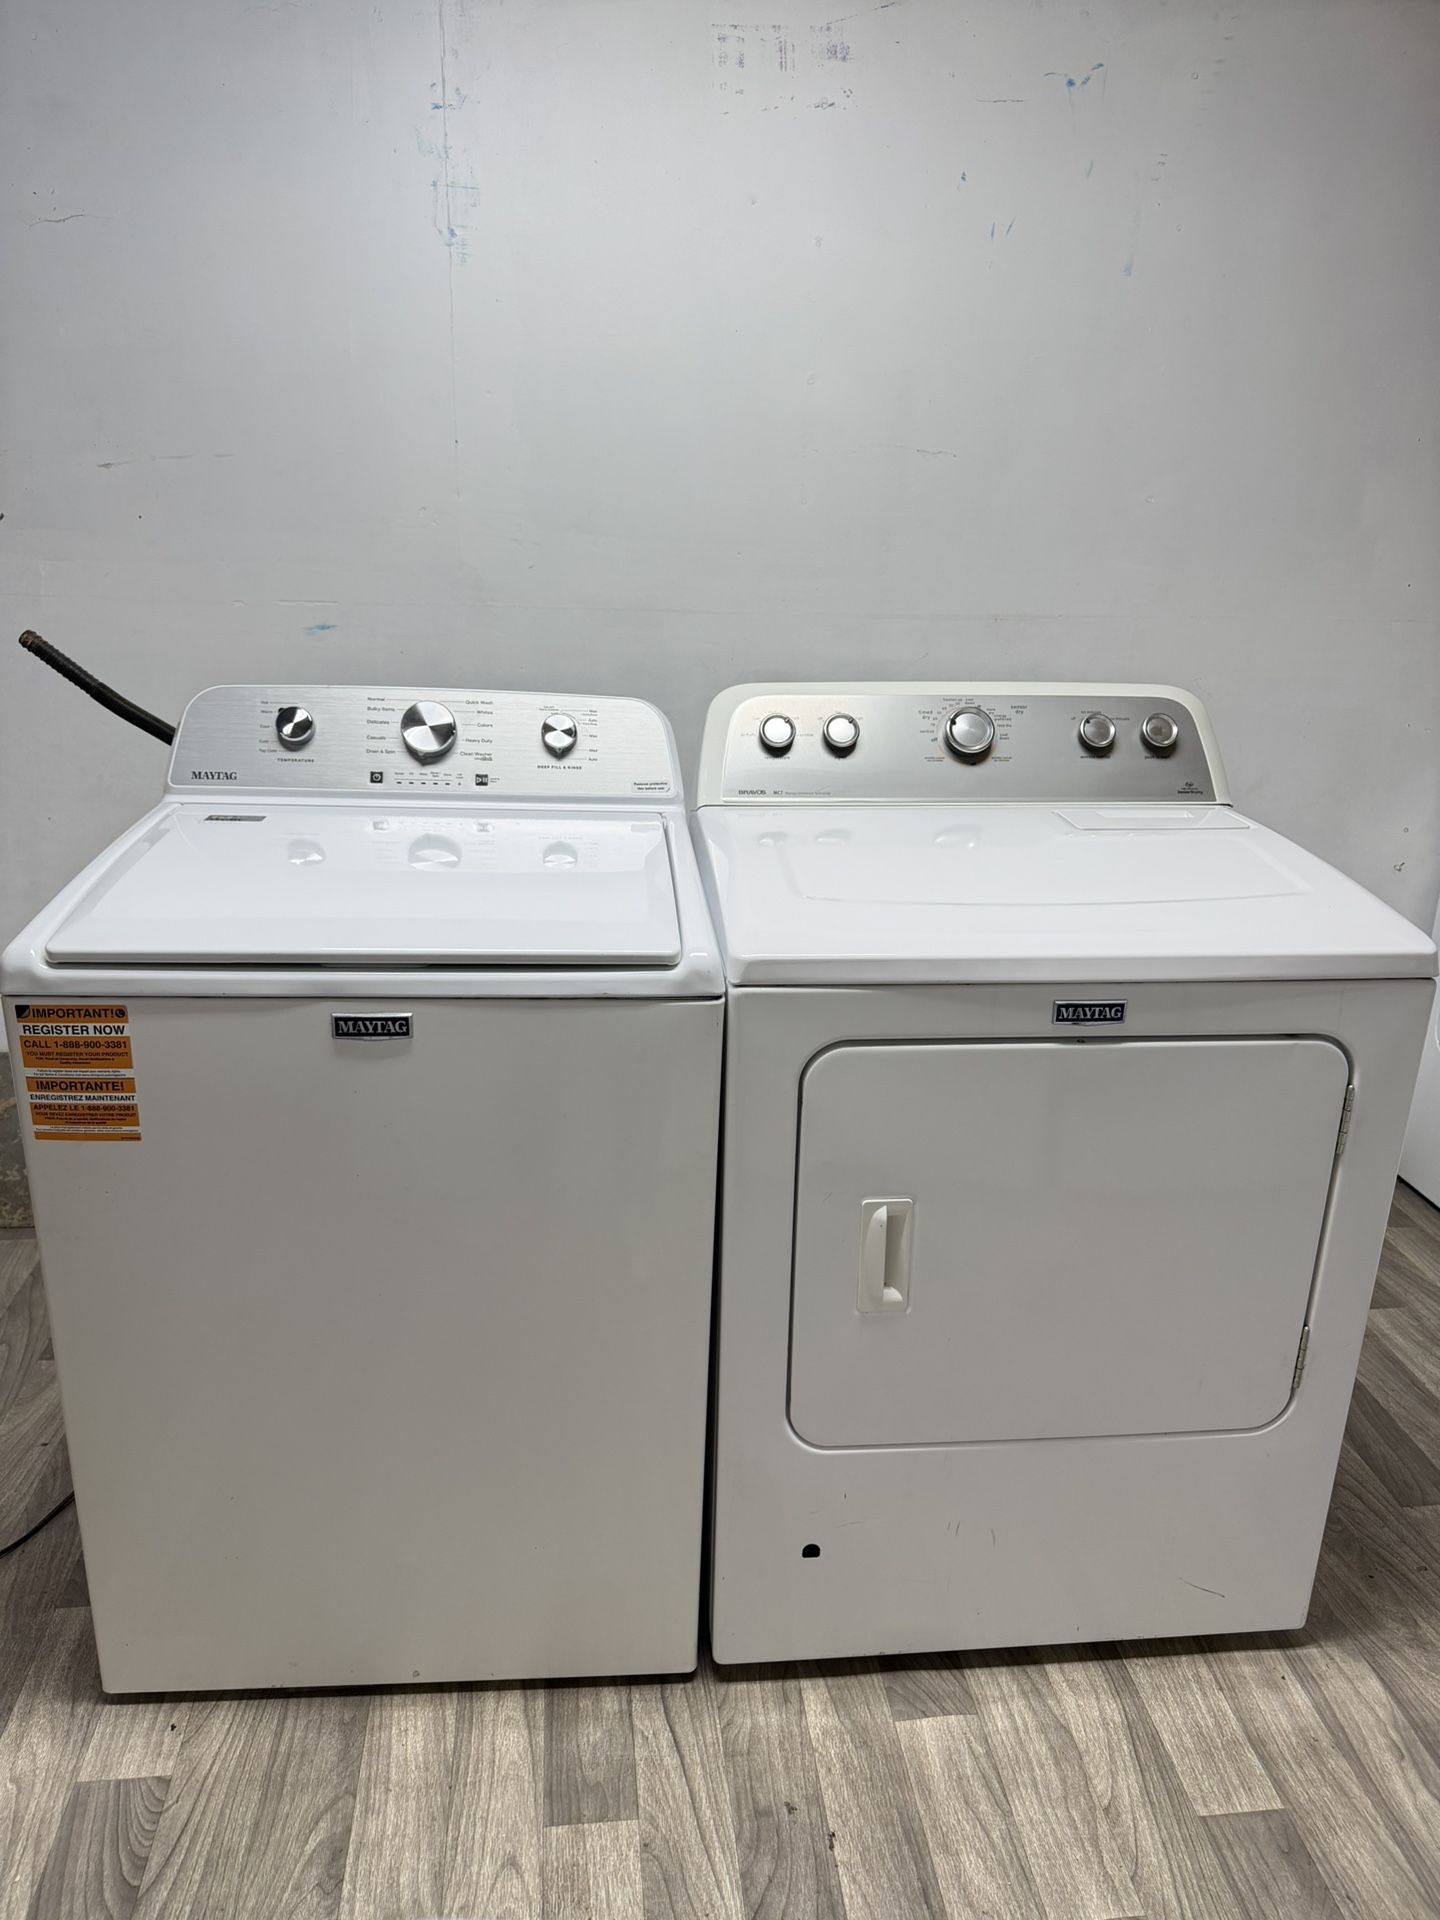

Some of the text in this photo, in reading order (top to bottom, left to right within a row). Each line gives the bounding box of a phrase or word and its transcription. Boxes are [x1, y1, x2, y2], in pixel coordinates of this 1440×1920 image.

[191, 771, 238, 781] MAYTAG
[32, 1008, 115, 1019] IMPORTANT!
[1058, 1006, 1123, 1019] MAYTAG
[23, 1024, 126, 1036] REGISTER NOW
[337, 1020, 408, 1034] MAYTAG
[23, 1039, 128, 1050] CALL 1-888-900-3381
[35, 1080, 125, 1092] IMPORTANTE!
[30, 1094, 136, 1102] ENREGISTREZ MAINTENANT
[33, 1104, 68, 1112] APPELEZ
